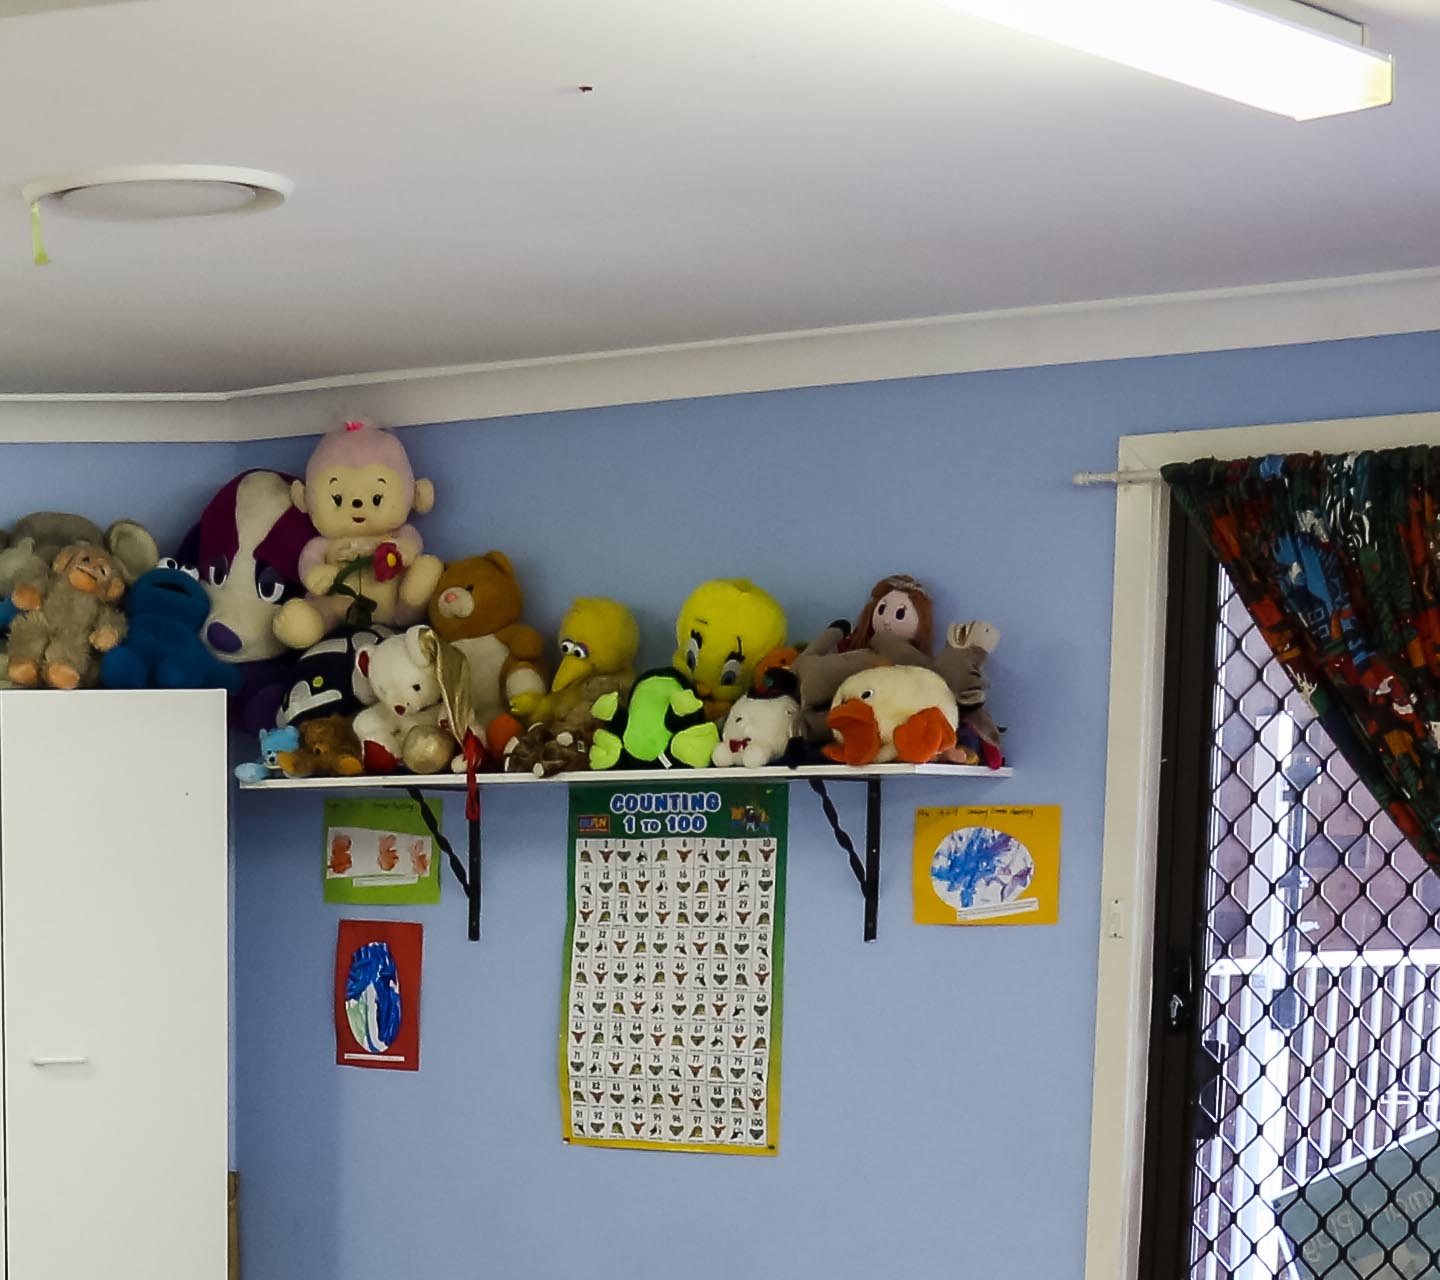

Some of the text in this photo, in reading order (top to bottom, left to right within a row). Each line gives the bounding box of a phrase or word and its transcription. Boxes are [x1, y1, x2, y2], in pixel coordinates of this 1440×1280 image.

[610, 792, 721, 814] COUNTING
[623, 815, 636, 834] 1
[641, 818, 661, 833] TO
[666, 814, 707, 832] 100
